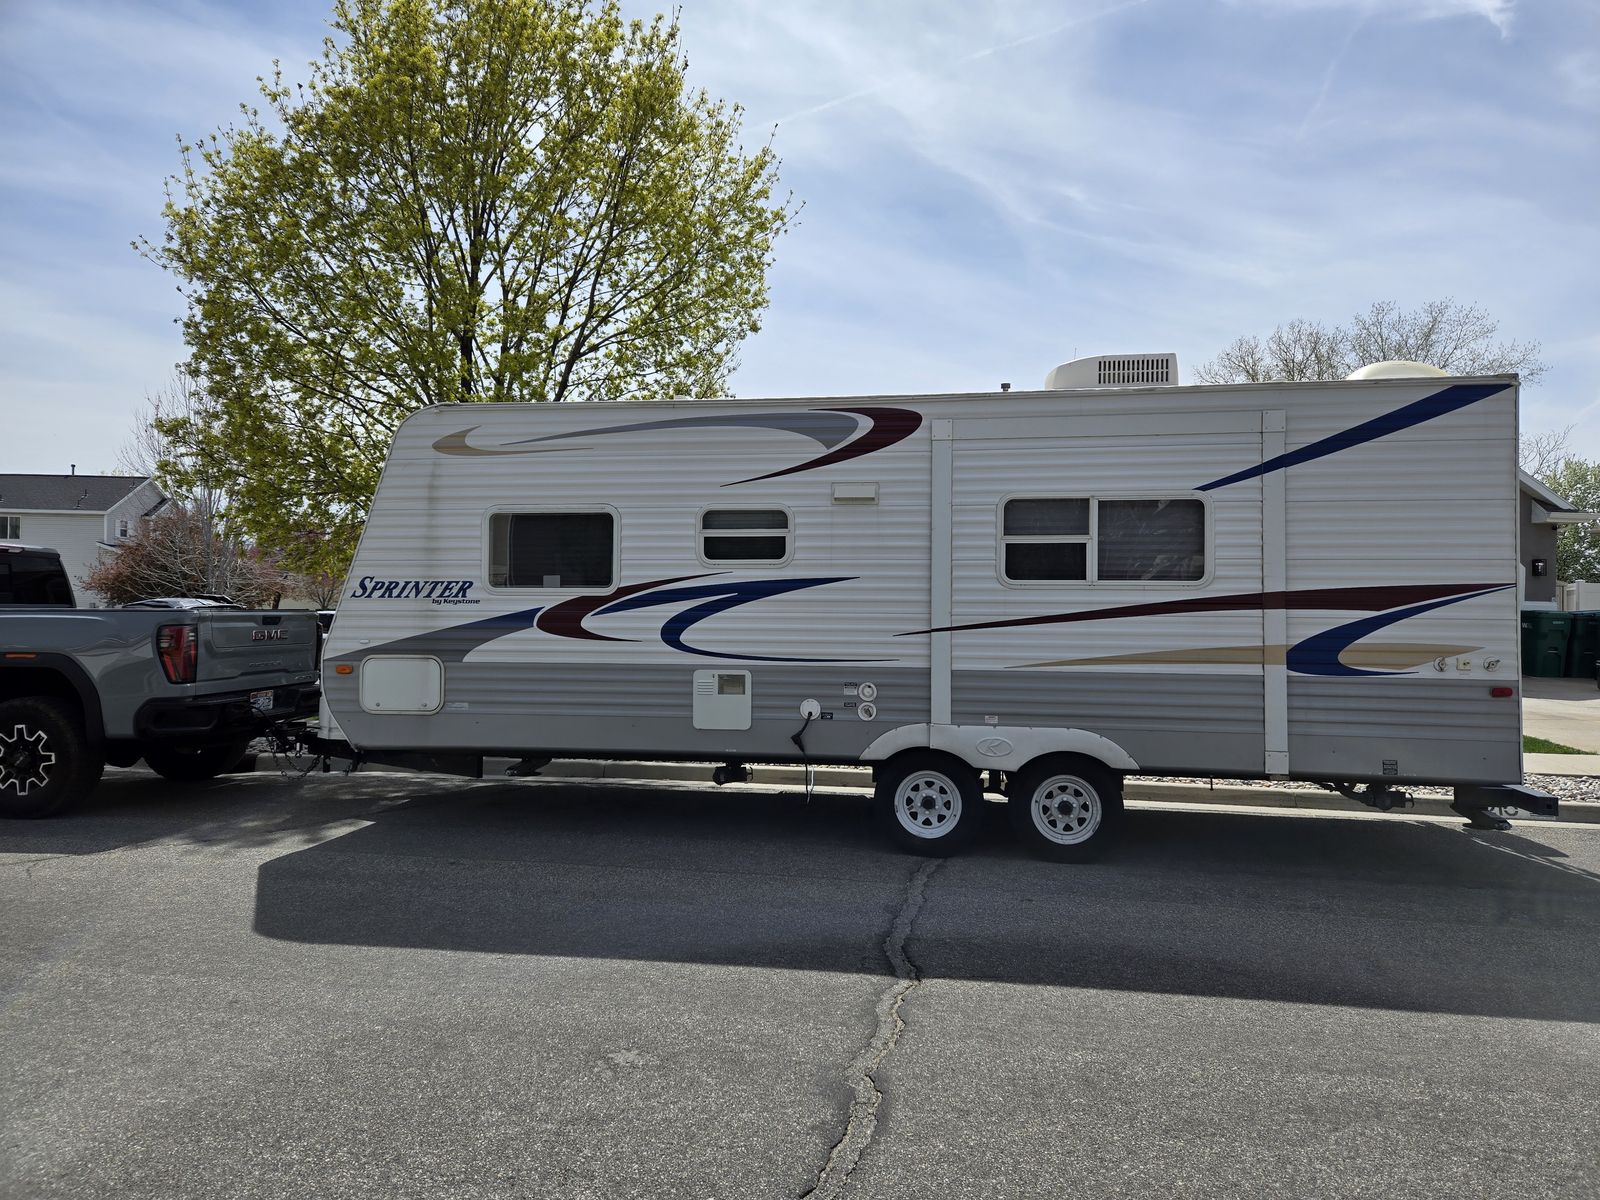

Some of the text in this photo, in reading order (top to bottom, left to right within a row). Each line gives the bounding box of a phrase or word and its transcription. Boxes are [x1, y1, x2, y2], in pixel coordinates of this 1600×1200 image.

[350, 576, 474, 598] SPRINTER
[432, 598, 481, 606] by Keystone
[251, 629, 288, 641] GMC
